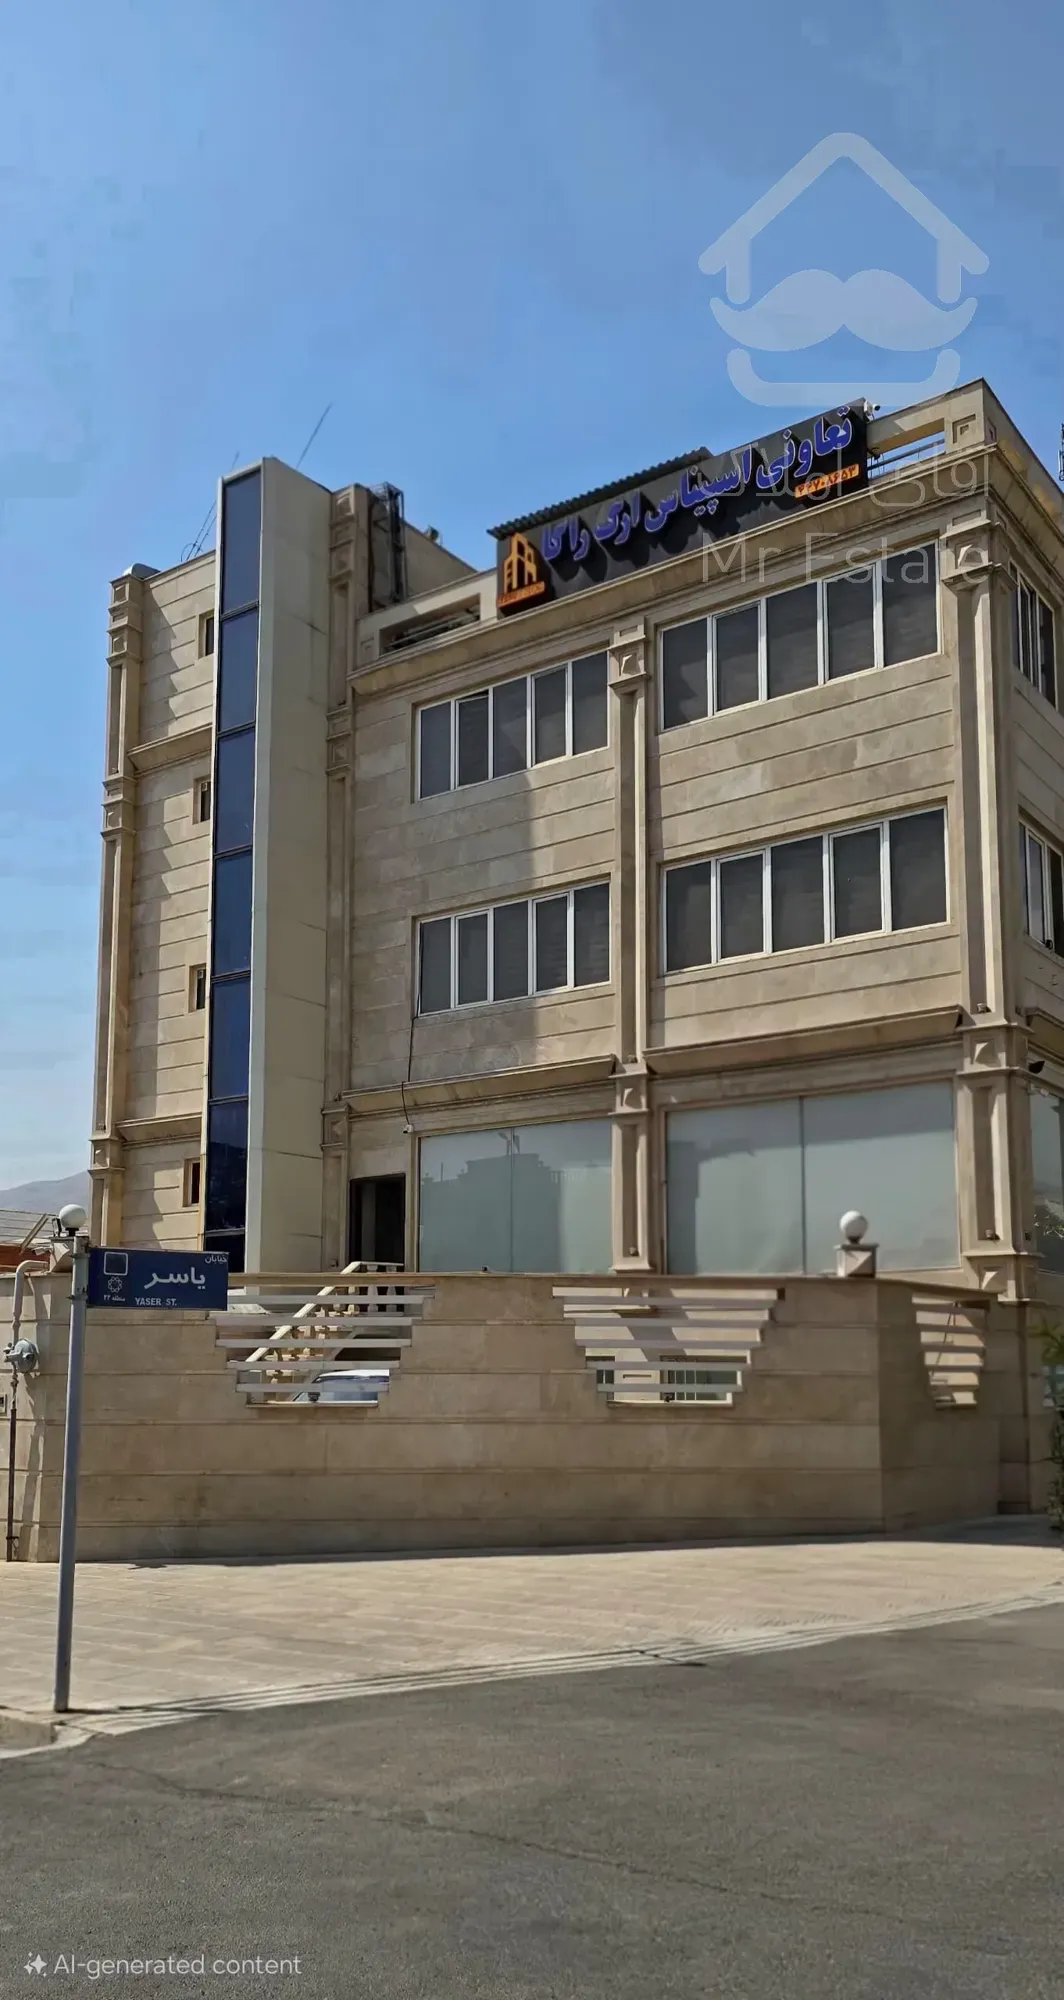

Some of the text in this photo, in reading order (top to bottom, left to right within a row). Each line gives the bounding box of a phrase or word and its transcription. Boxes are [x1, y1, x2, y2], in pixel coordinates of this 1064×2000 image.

[755, 405, 853, 489] تعاونی
[204, 1254, 228, 1264] خیابان
[143, 1266, 206, 1289] یاسر
[135, 1297, 178, 1307] YASER ST.
